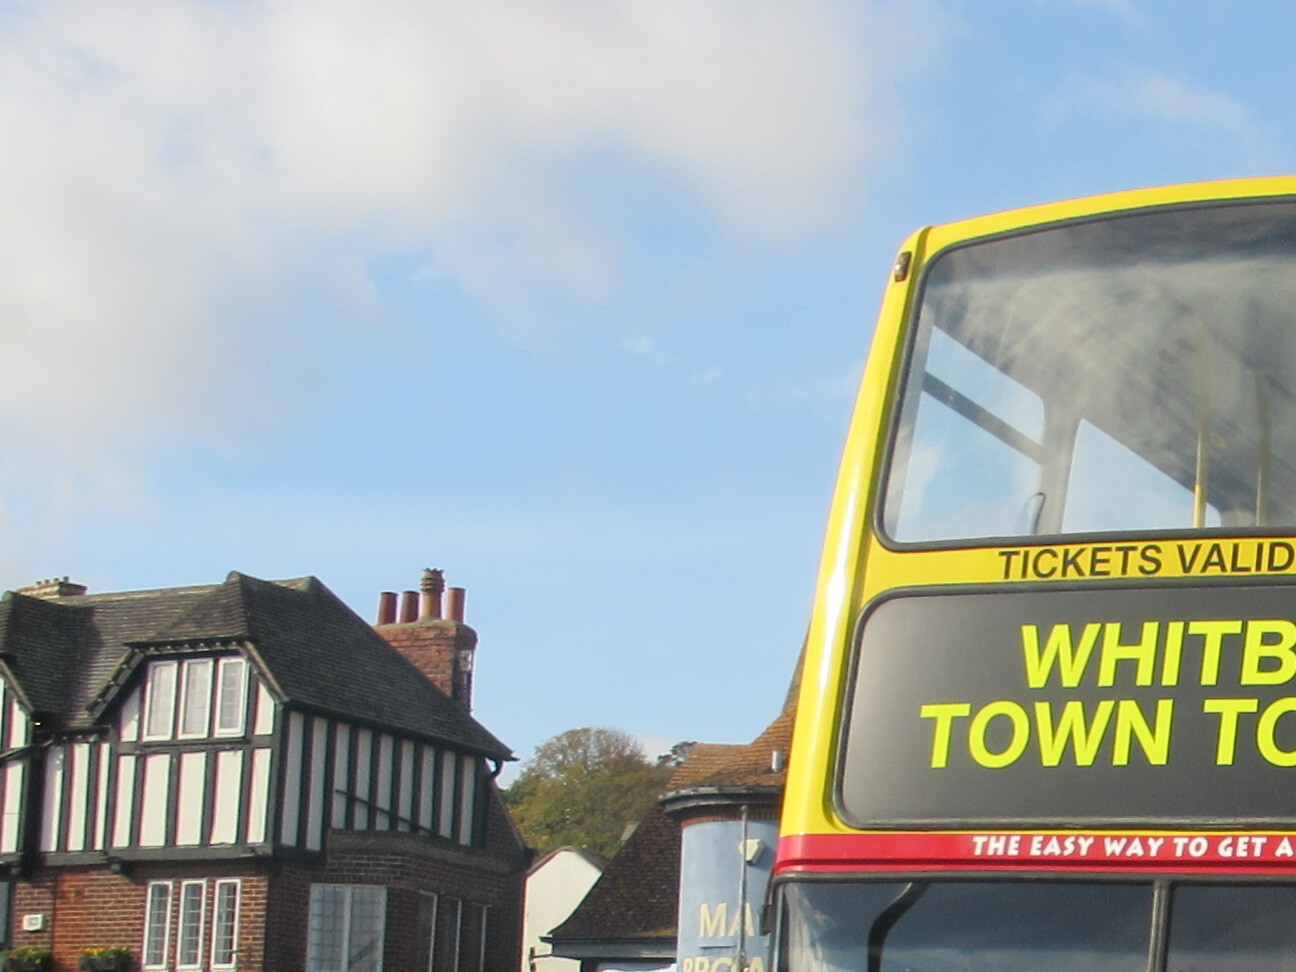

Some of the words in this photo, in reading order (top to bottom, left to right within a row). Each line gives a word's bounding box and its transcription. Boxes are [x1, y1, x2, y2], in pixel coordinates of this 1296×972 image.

[998, 544, 1162, 580] TICKETS
[1177, 540, 1296, 575] VALID
[919, 698, 1175, 768] TOWN
[972, 835, 1020, 857] THE
[1029, 835, 1095, 857] EASY
[1104, 836, 1165, 858] WAY
[1173, 837, 1209, 858] TO
[1217, 836, 1267, 858] GET
